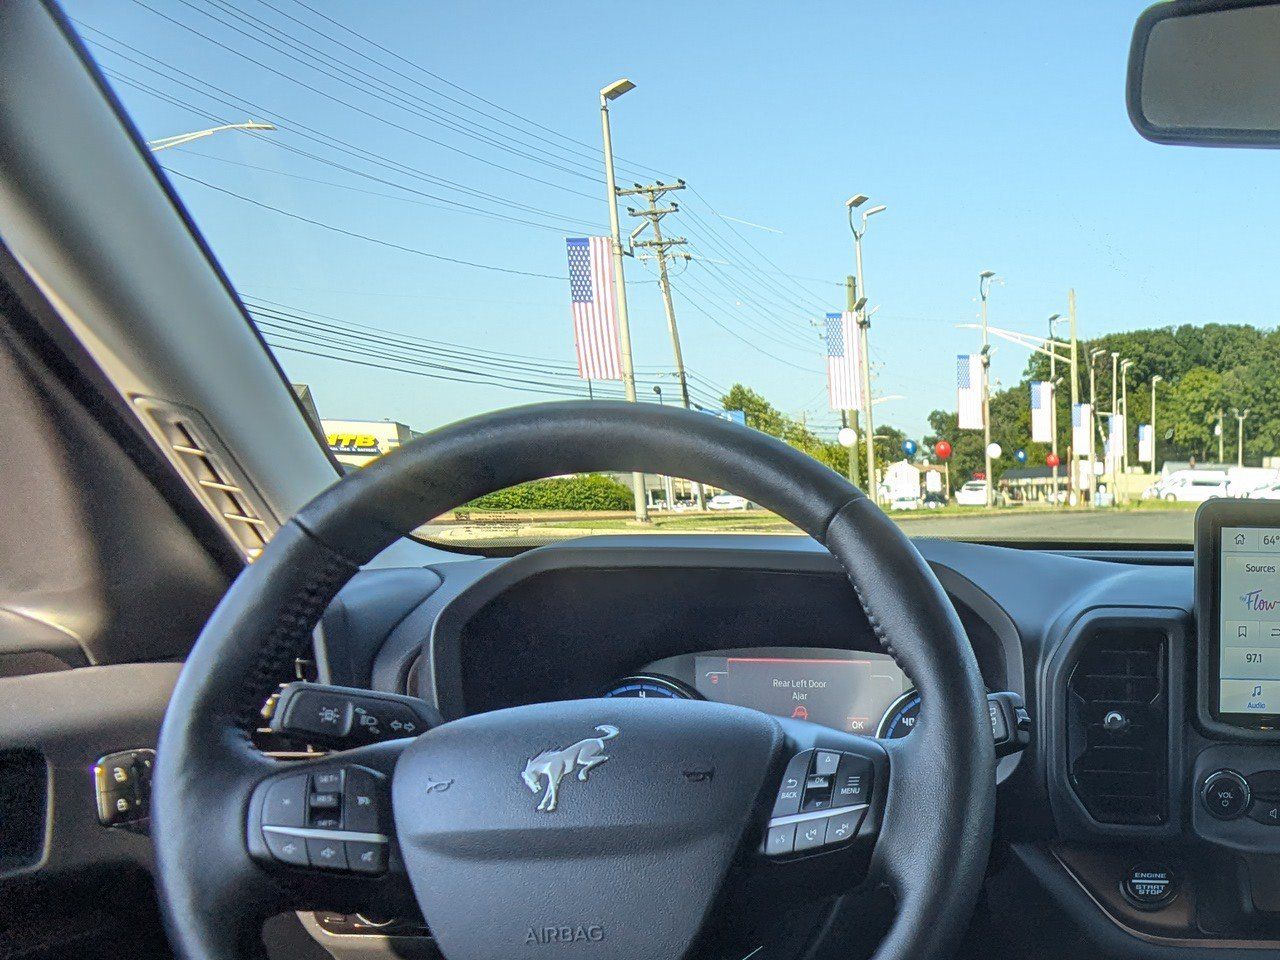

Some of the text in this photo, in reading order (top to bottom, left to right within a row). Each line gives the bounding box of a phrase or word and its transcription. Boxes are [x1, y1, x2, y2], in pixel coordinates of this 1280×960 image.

[1263, 534, 1280, 545] 64°
[1245, 563, 1276, 573] Sources
[1246, 588, 1280, 611] Flow
[1245, 653, 1262, 664] 97.1
[772, 679, 827, 689] Rear Left Door
[792, 691, 808, 701] Ajar
[1246, 701, 1266, 709] Audio
[851, 720, 864, 730] OK
[815, 776, 825, 784] OK
[781, 791, 797, 800] BACK
[841, 787, 861, 796] MENU
[526, 925, 604, 944] AIRBAG
